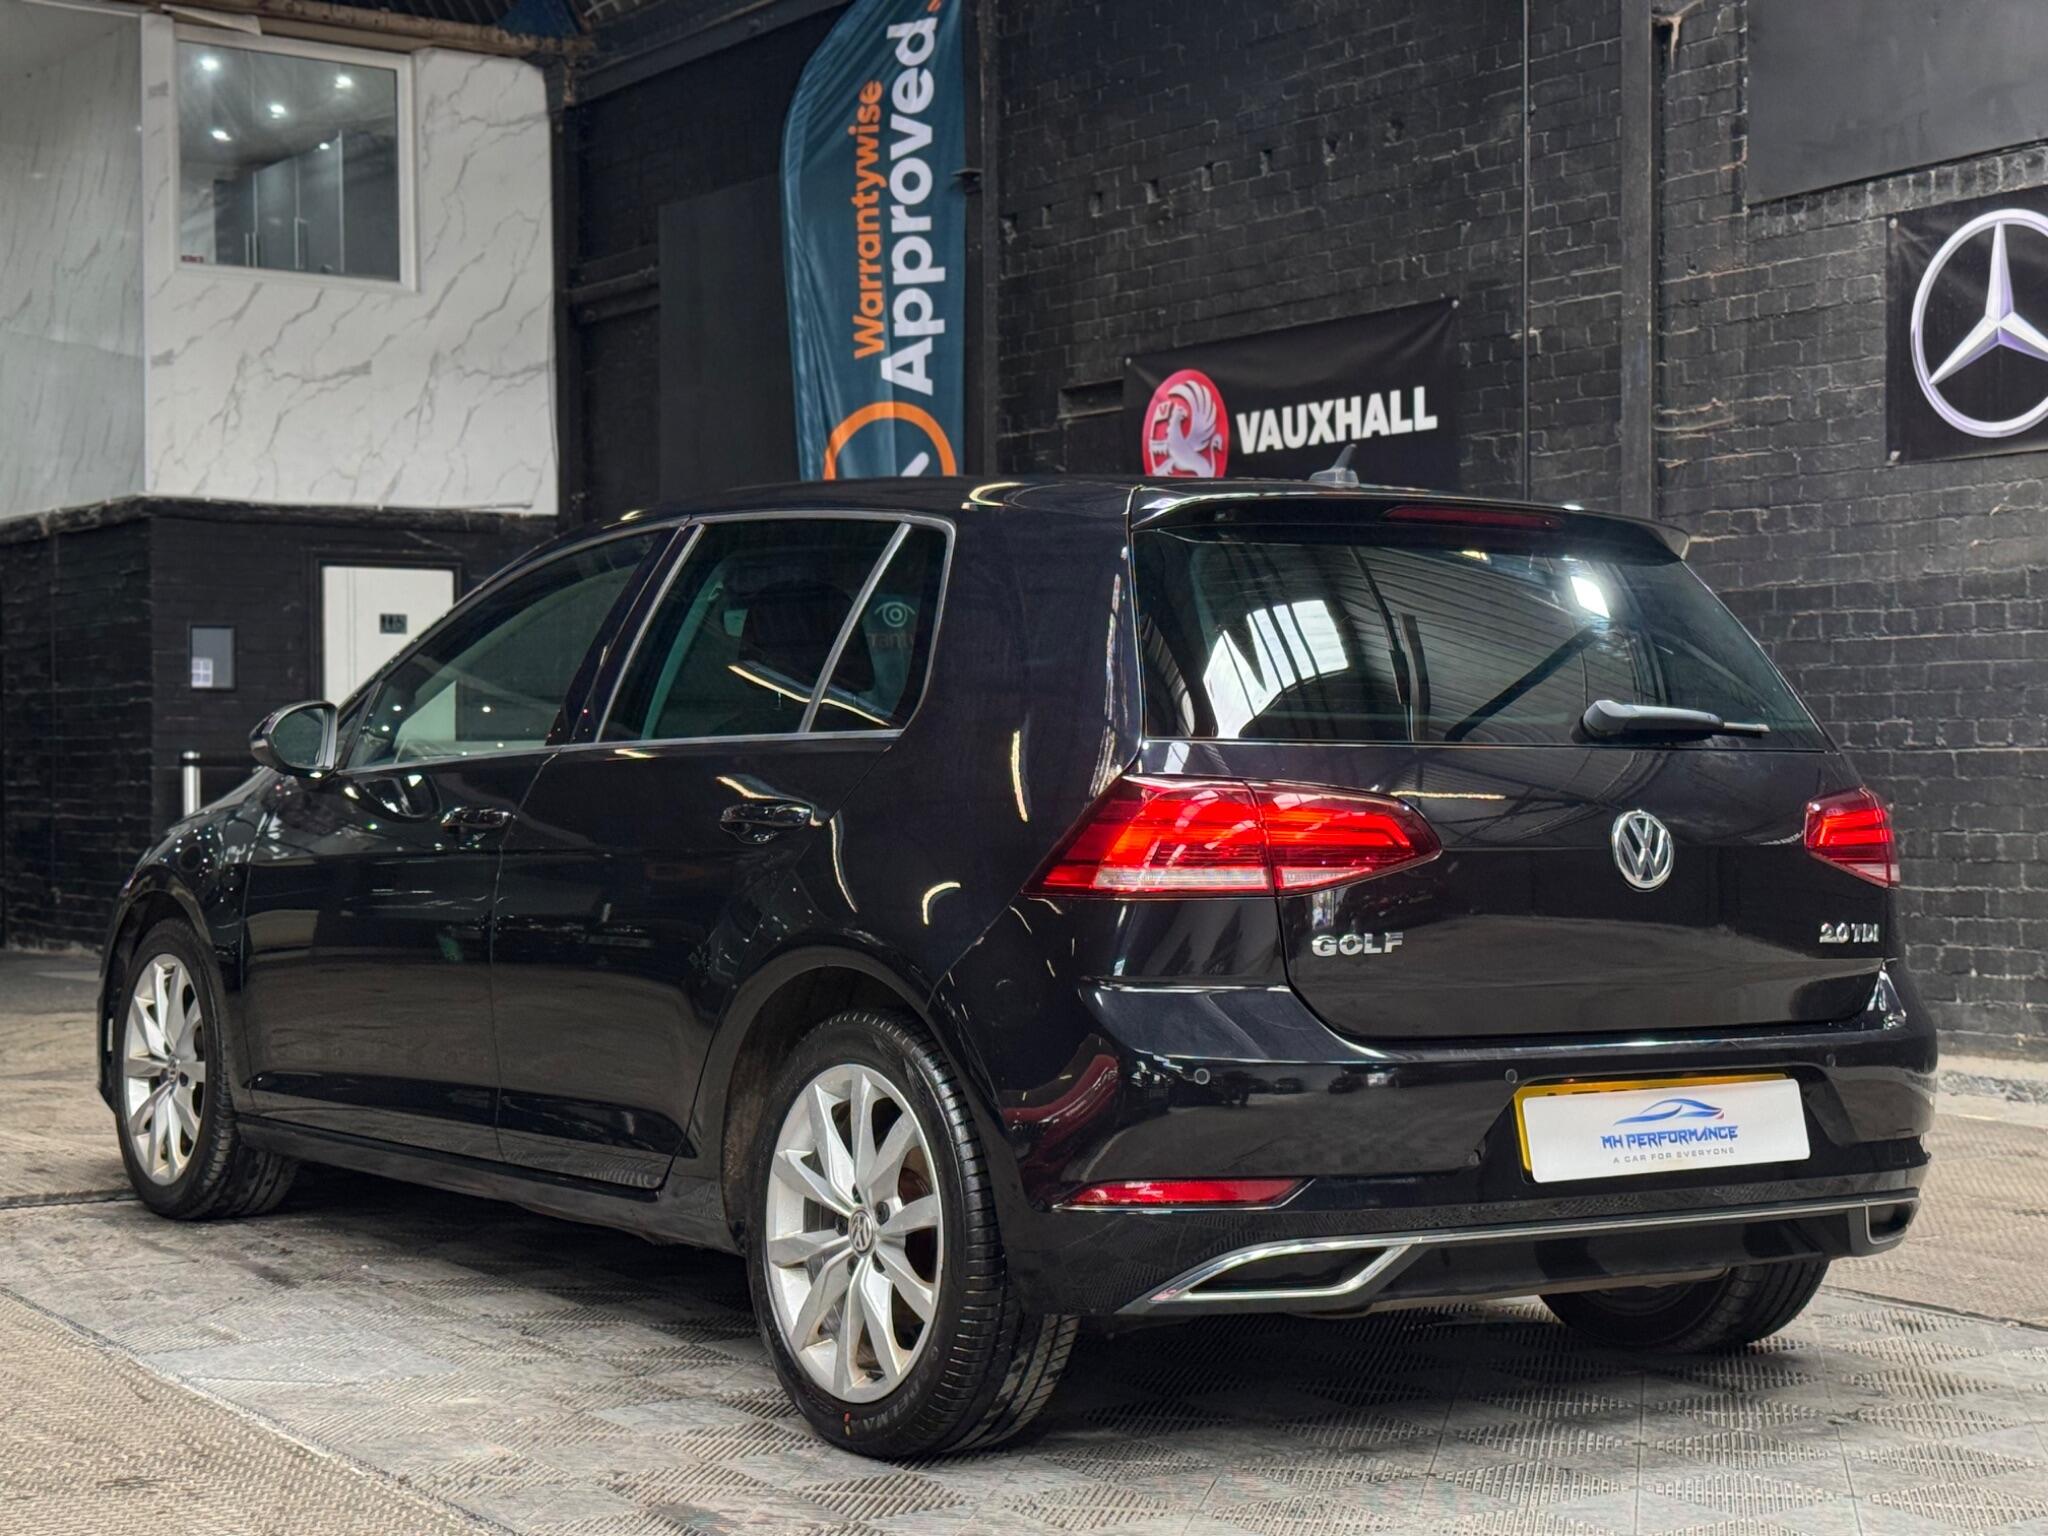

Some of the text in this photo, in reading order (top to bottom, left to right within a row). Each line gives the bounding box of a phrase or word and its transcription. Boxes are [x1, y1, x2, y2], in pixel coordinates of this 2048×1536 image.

[848, 80, 887, 359] Warrantywise
[880, 17, 945, 396] Approved
[1236, 386, 1438, 454] VAUXHALL
[1311, 931, 1404, 957] GOLF
[1851, 922, 1879, 943] TDI
[1600, 1125, 1738, 1150] MH PERFORMANCE
[1613, 1147, 1735, 1164] A CAR FOR EVERYONE
